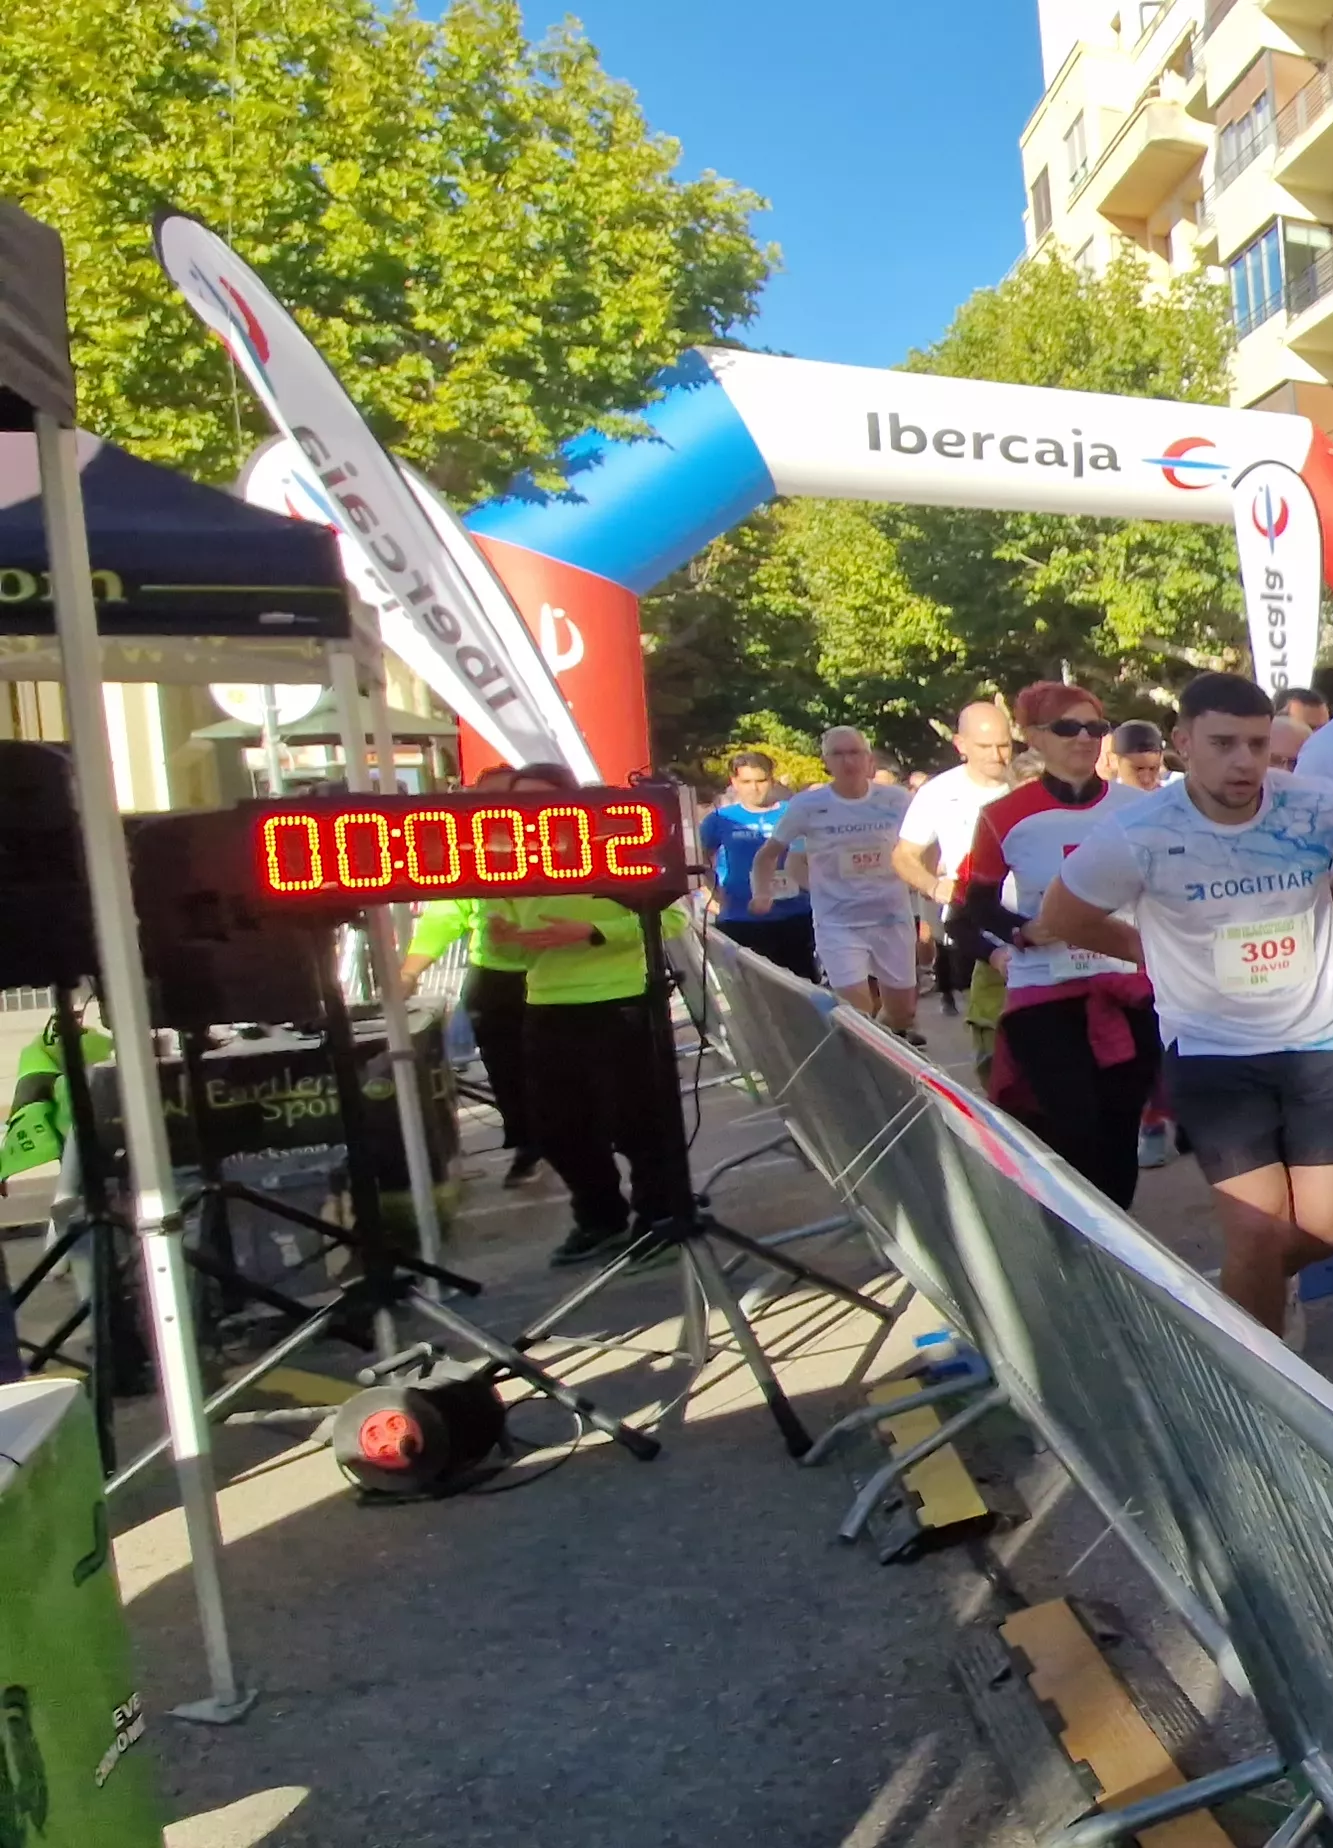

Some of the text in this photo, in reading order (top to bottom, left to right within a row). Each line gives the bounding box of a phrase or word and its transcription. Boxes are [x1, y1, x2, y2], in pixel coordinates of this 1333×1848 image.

[866, 411, 1122, 479] Ibercaja
[263, 805, 654, 891] 00:00:02
[1210, 869, 1314, 900] COGITIAR
[1240, 935, 1297, 963] 309
[1250, 960, 1291, 974] DAVID
